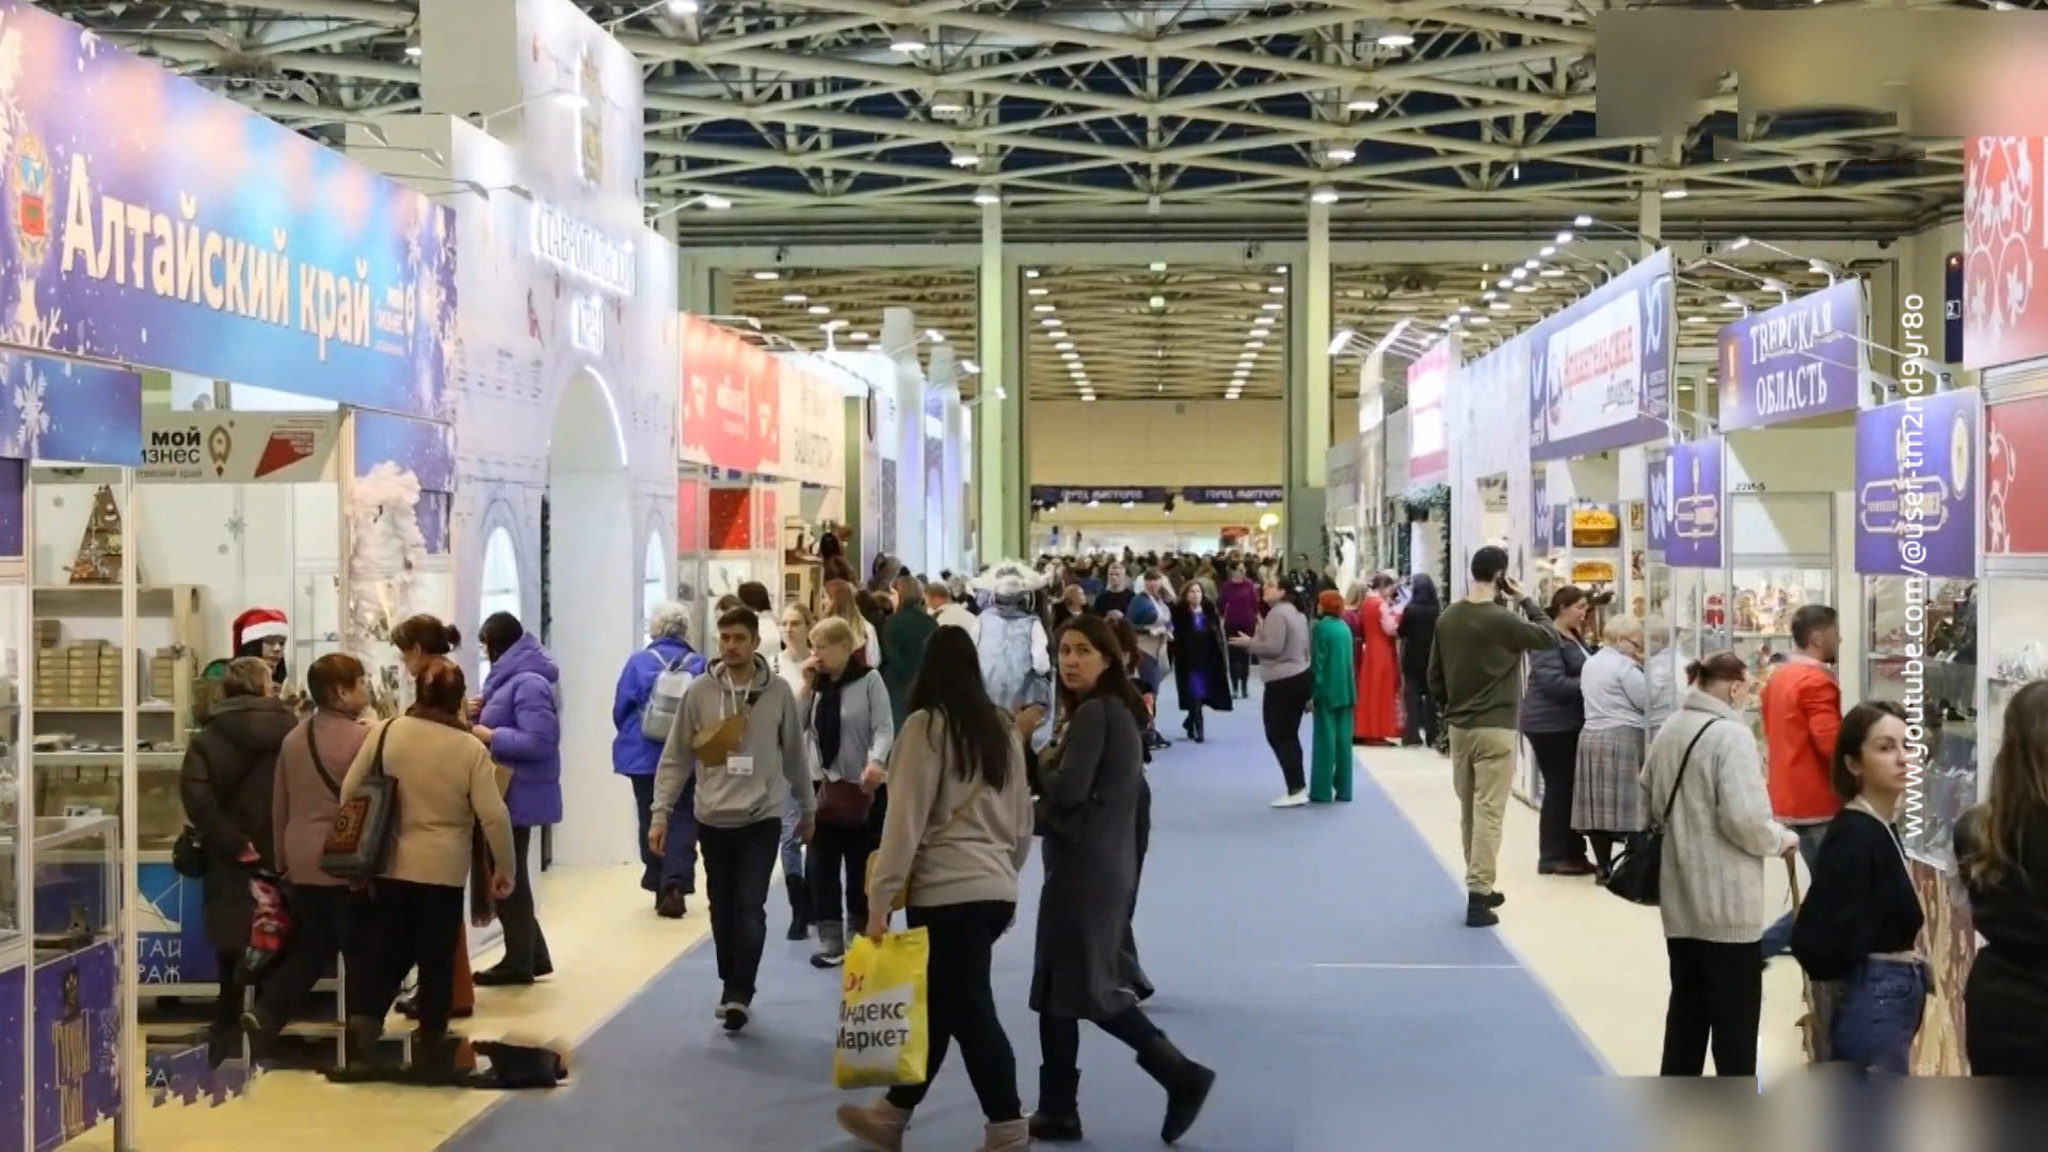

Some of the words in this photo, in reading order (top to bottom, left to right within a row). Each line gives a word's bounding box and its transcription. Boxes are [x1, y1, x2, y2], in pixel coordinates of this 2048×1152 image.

[61, 153, 290, 328] Алтайский
[301, 256, 371, 363] край
[1750, 301, 1833, 364] ТВЕРСКАЯ
[1756, 362, 1828, 416] ОБЛАСТЬ
[141, 448, 200, 464] изнес
[136, 937, 182, 958] ТАЙ
